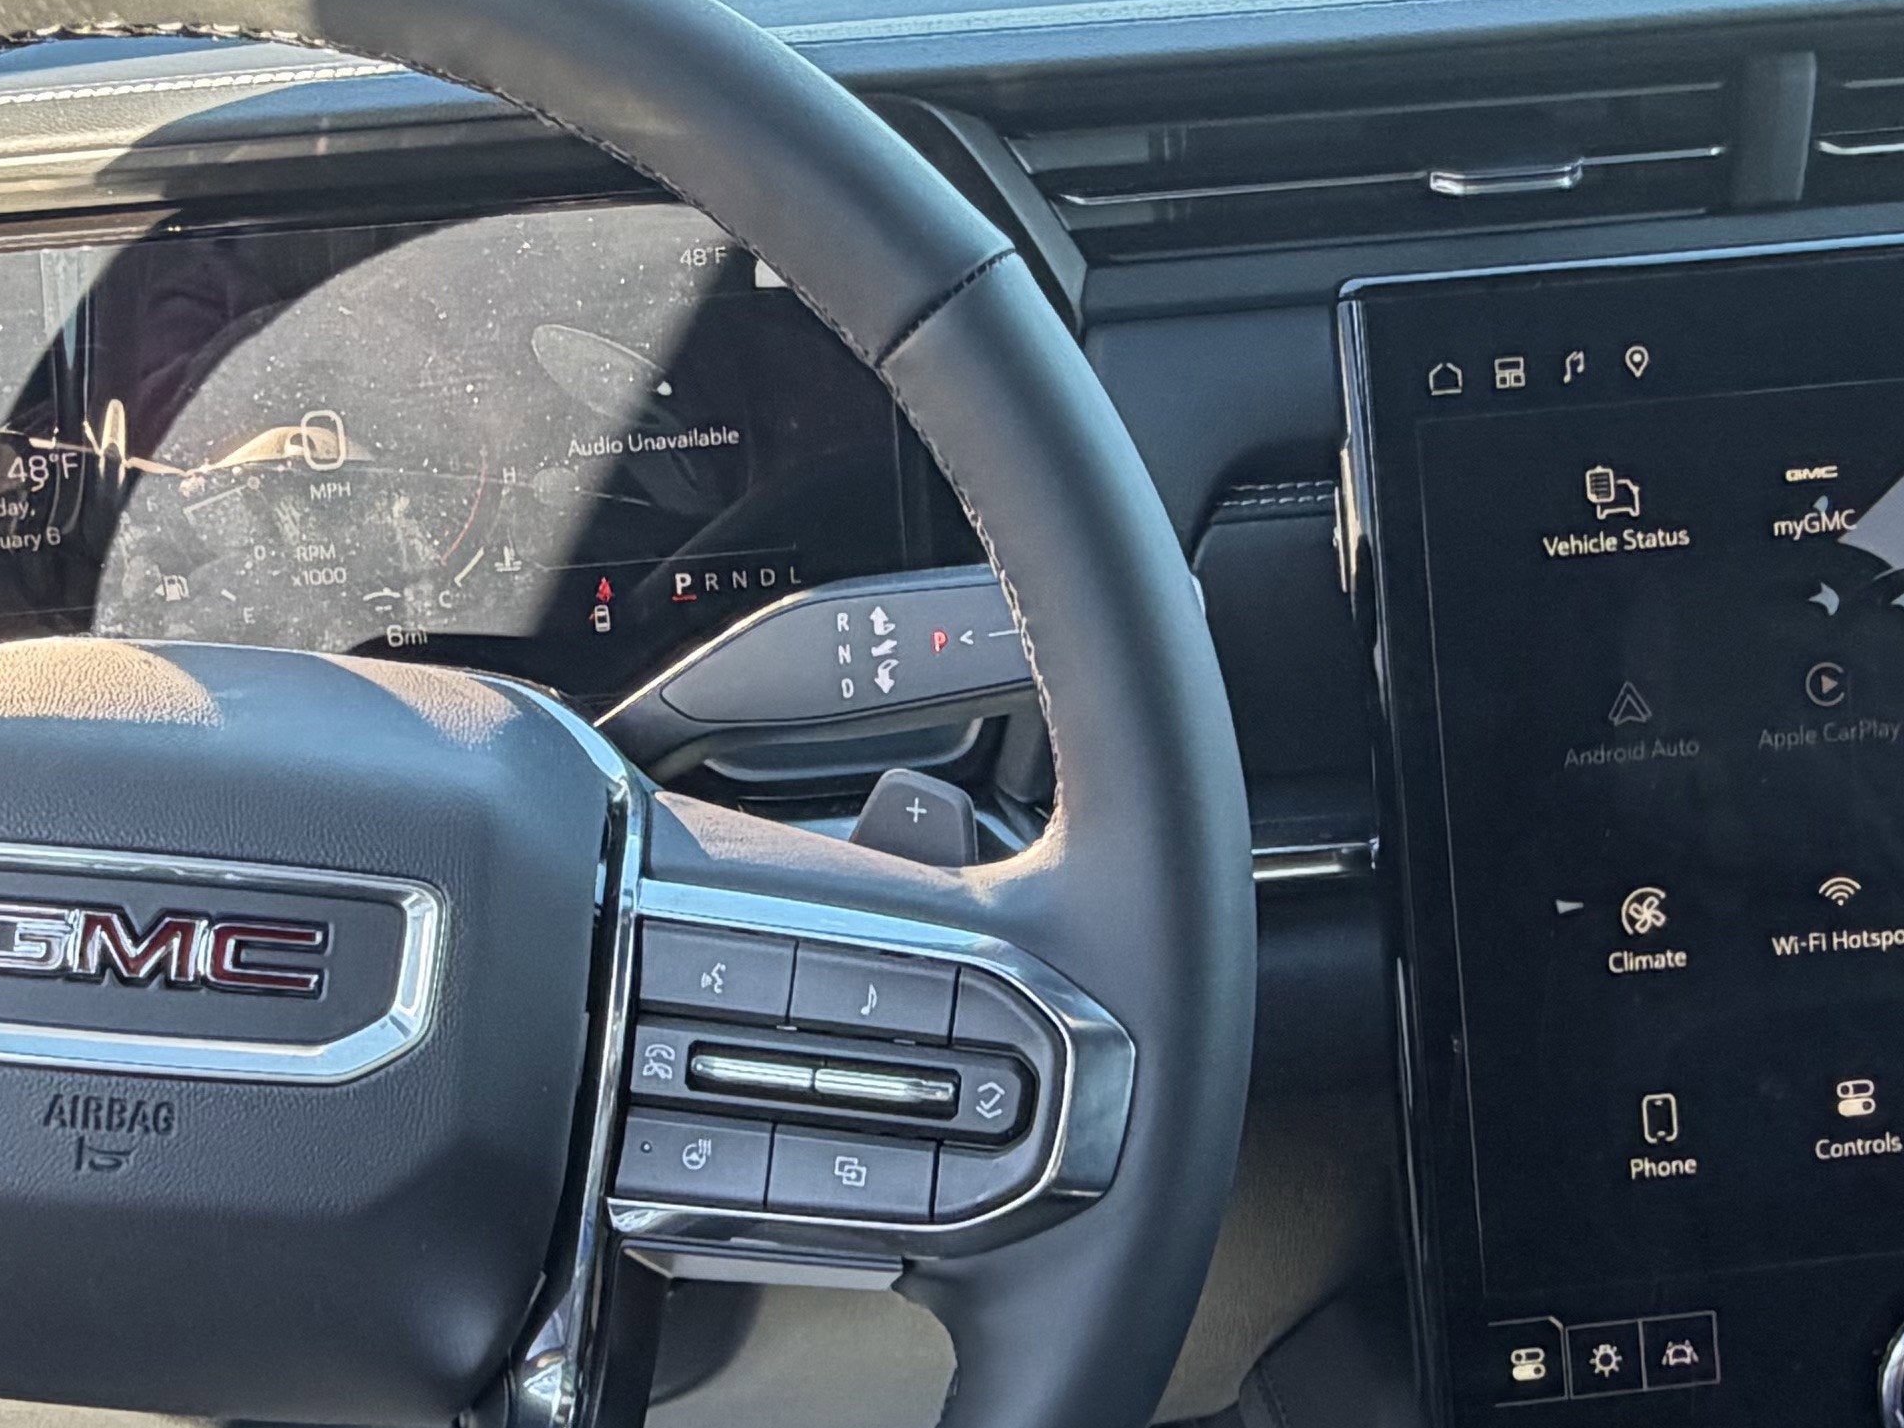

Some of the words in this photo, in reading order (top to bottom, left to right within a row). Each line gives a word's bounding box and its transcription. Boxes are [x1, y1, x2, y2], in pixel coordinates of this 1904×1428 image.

[567, 433, 623, 457] Audio
[628, 426, 740, 452] Unavailable
[7, 452, 79, 484] 48°F
[502, 466, 516, 484] H
[310, 481, 351, 500] MPH
[46, 526, 61, 545] 6
[1773, 509, 1857, 541] myGMC
[296, 545, 336, 562] RPM
[1543, 532, 1618, 558] Vehicle
[1622, 527, 1690, 551] Status
[292, 567, 346, 586] x1000
[674, 572, 692, 595] P
[704, 571, 719, 592] R
[732, 570, 748, 589] N
[759, 568, 776, 587] D
[789, 565, 802, 584] L
[836, 612, 850, 632] R
[931, 630, 948, 653] P
[838, 644, 852, 665] N
[840, 678, 854, 699] D
[1758, 725, 1818, 750] Apple
[1822, 718, 1902, 743] CarPlay
[1564, 742, 1646, 768] Android
[1651, 738, 1700, 760] Auto
[1771, 932, 1827, 956] Wi-Fi
[1608, 949, 1688, 974] Climate
[42, 1093, 176, 1137] AIRBAG
[1815, 1132, 1903, 1160] Controls
[1630, 1157, 1698, 1181] Phone
